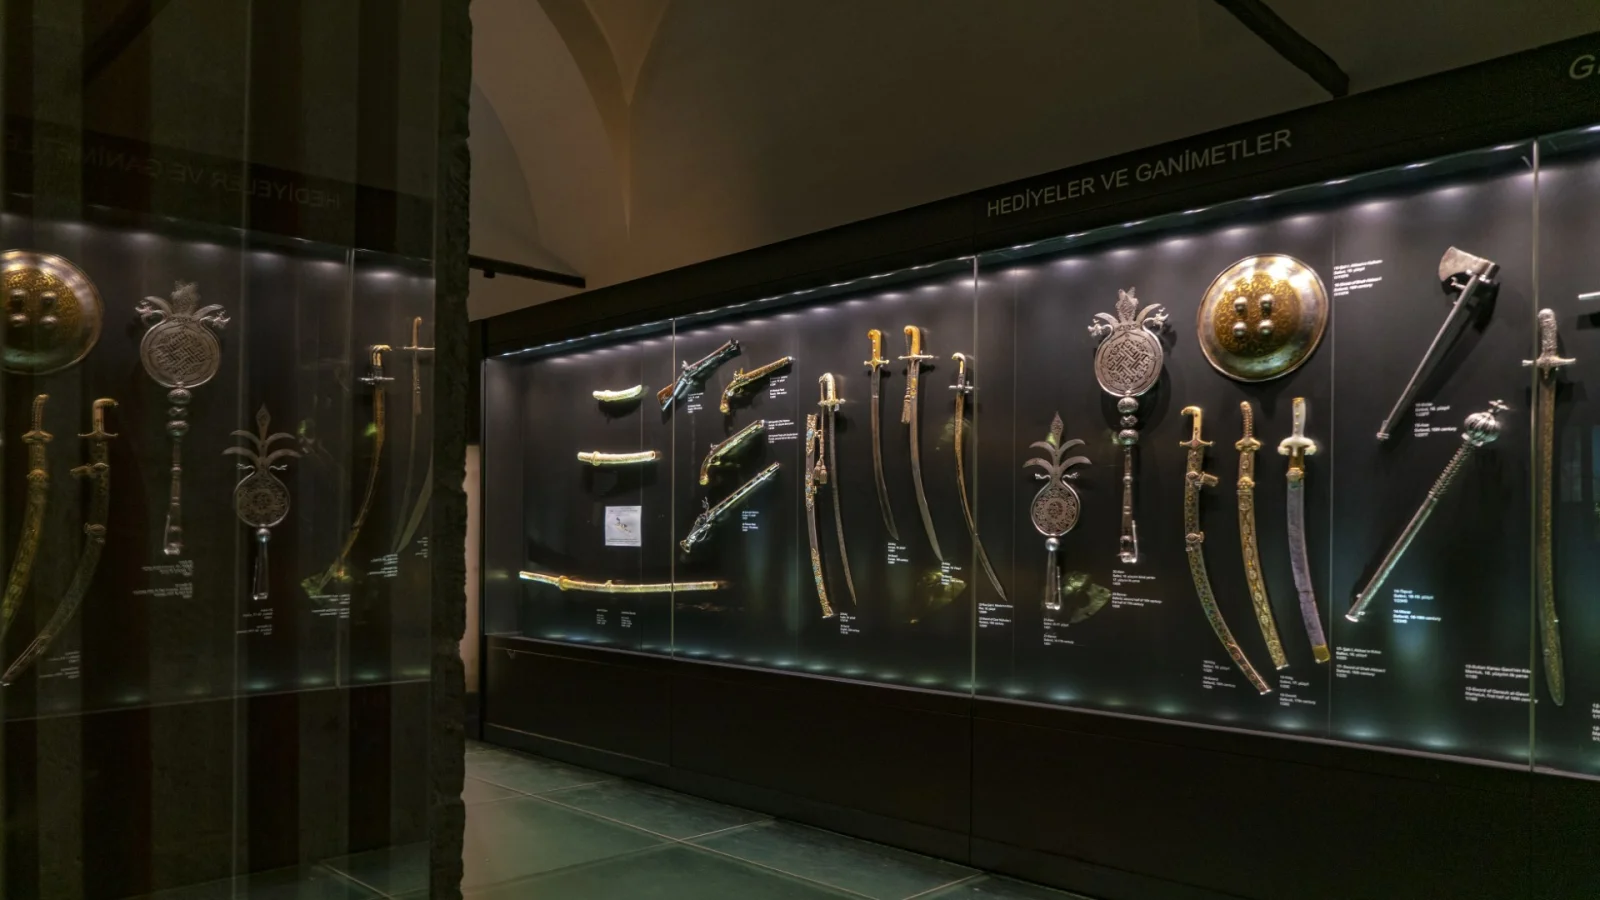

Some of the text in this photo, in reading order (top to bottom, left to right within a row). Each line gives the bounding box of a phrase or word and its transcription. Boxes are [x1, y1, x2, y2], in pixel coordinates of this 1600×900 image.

[1569, 54, 1600, 79] G
[987, 128, 1292, 217] HEDİYELER VE GANİMETLER
